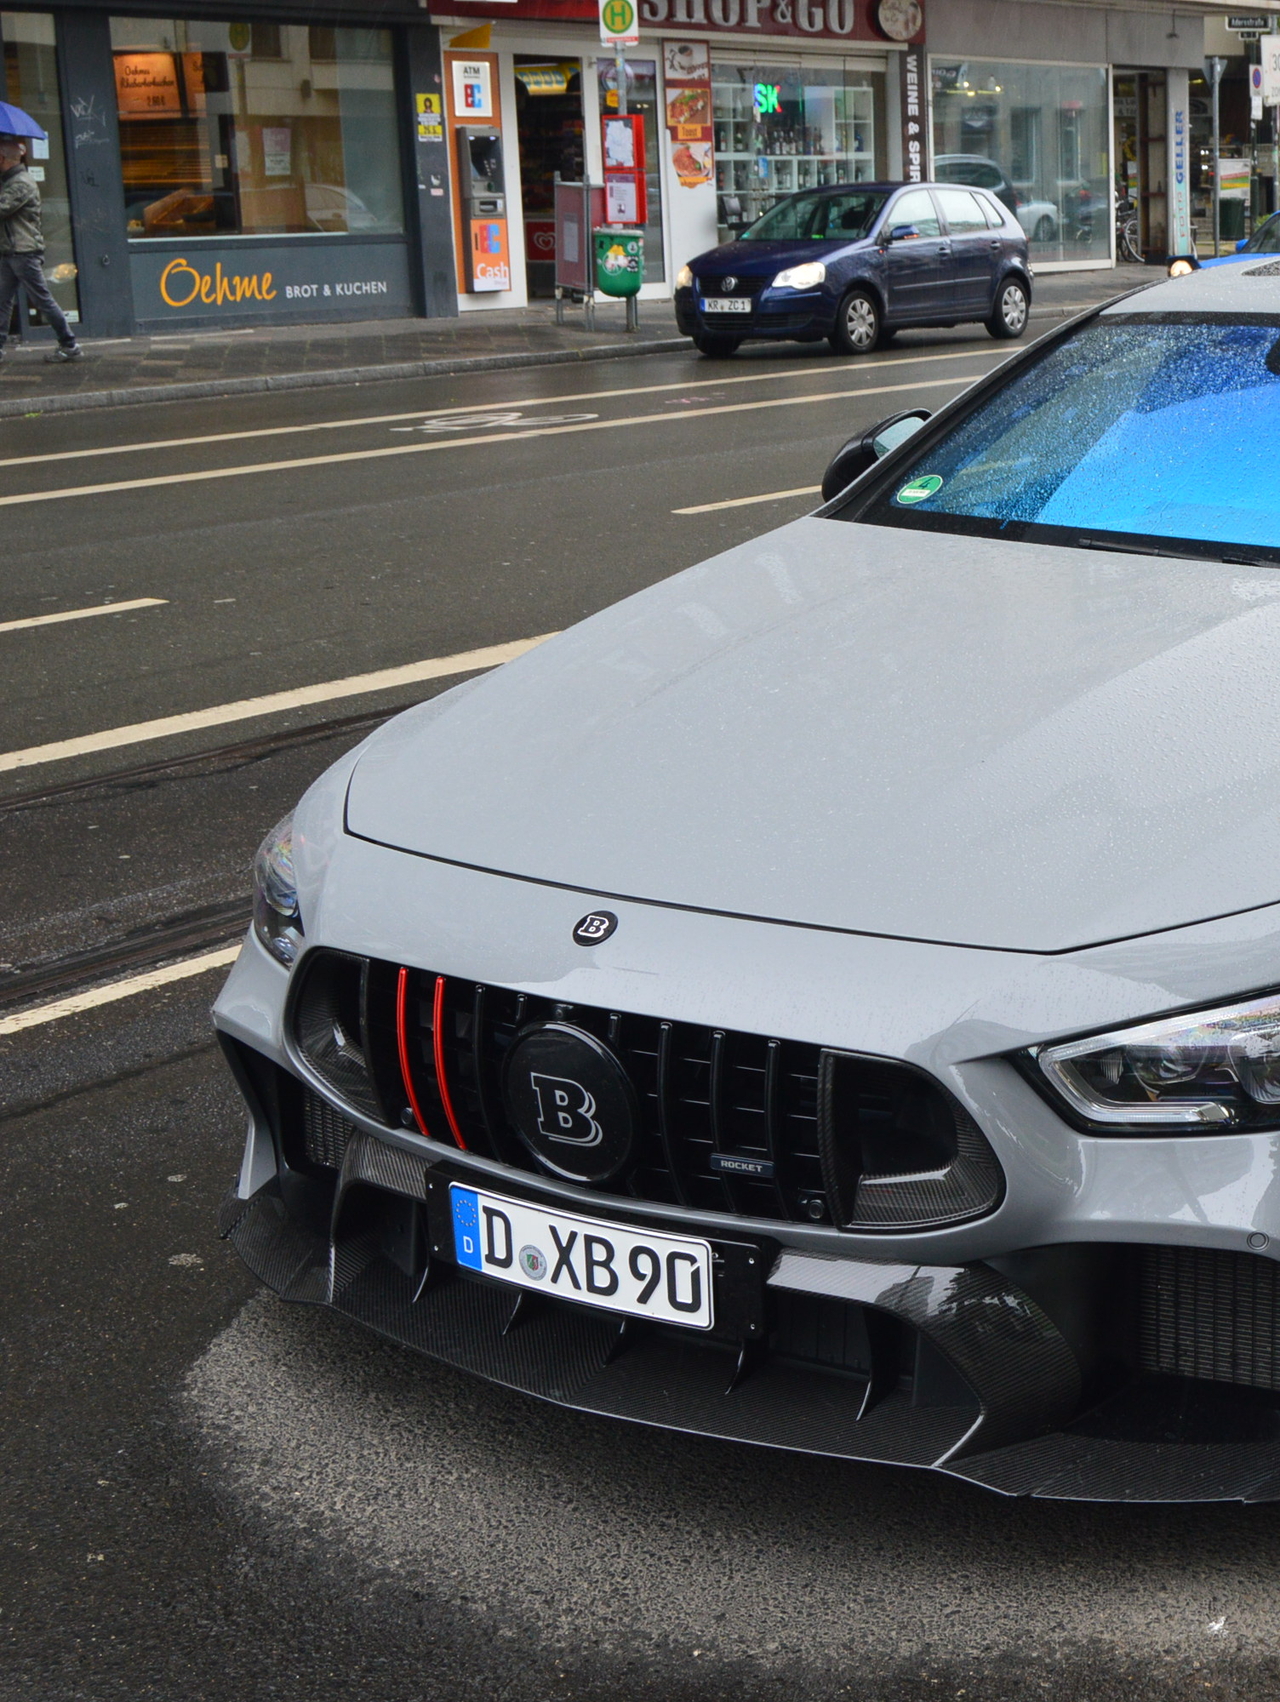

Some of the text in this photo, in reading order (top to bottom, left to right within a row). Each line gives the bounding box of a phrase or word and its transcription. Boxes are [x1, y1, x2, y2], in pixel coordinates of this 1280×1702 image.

[463, 66, 480, 74] ATM
[906, 54, 919, 117] WEINE
[908, 121, 920, 135] &
[1175, 110, 1184, 184] GELLER
[160, 257, 388, 307] Oehme BROT & KUCHEN
[476, 261, 509, 280] Cash
[720, 1159, 763, 1173] ROCKET
[482, 1204, 513, 1269] D
